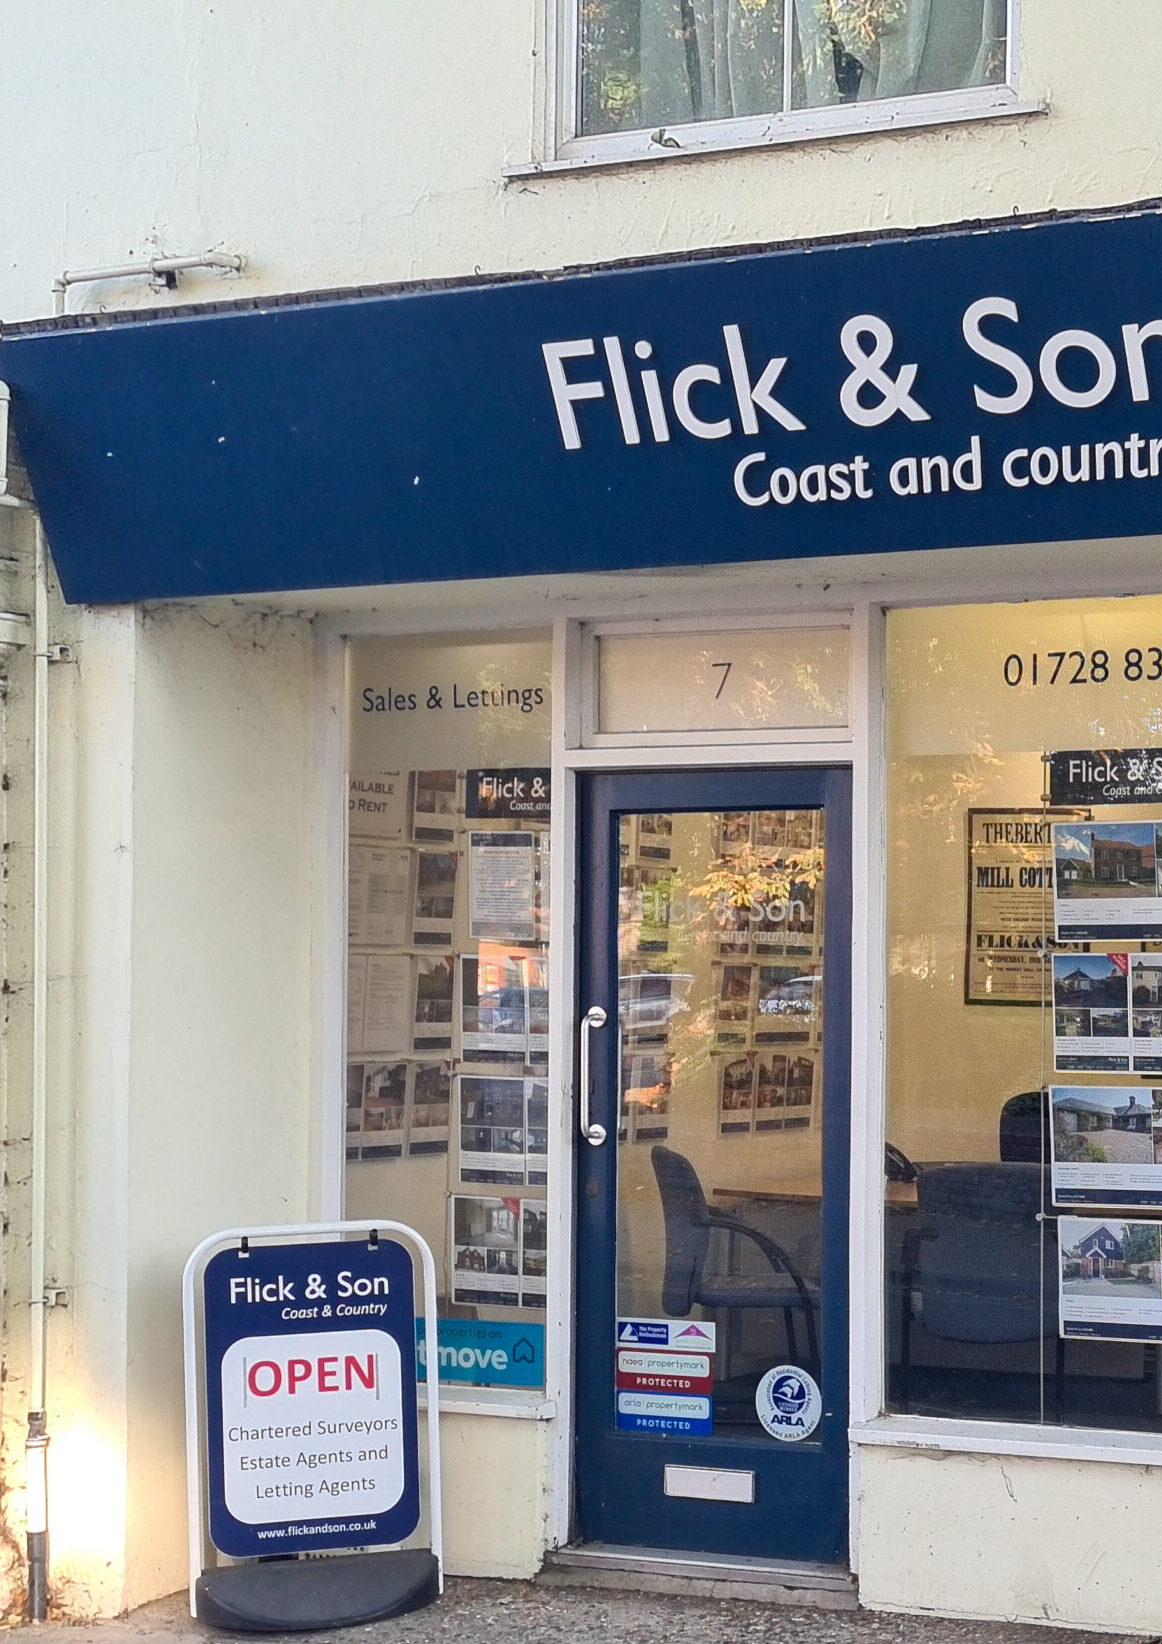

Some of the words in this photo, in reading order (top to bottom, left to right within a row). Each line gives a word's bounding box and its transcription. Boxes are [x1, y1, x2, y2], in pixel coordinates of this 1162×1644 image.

[541, 323, 806, 450] Flick
[839, 314, 931, 427] &
[733, 450, 873, 507] Coast
[888, 434, 983, 494] and
[1003, 650, 1109, 687] 01728
[711, 661, 732, 700] 7
[362, 686, 417, 713] Sales
[426, 685, 443, 711] &
[453, 682, 544, 712] Lettings
[1068, 760, 1119, 783] Flick
[1126, 758, 1144, 780] &
[350, 781, 396, 796] AILABLE
[482, 776, 524, 798] Flick
[531, 776, 546, 798] &
[1102, 783, 1131, 797] Coast
[357, 798, 388, 814] RENT
[510, 801, 534, 812] Coast
[976, 866, 1014, 889] MILL
[1019, 866, 1054, 889] COTT
[976, 934, 1030, 949] FLICK
[229, 1275, 296, 1305] Flick
[304, 1273, 328, 1299] &
[337, 1271, 389, 1298] Son
[281, 1305, 318, 1320] Coast
[321, 1304, 333, 1317] &
[335, 1302, 388, 1318] Country
[248, 1353, 376, 1398] OPEN
[622, 1358, 644, 1367] naea
[647, 1359, 705, 1371] propertymark
[636, 1377, 691, 1389] PROTECTED
[623, 1398, 642, 1408] arla
[646, 1401, 704, 1412] propertymark
[228, 1420, 313, 1443] Chartered
[317, 1416, 398, 1438] Surveyors
[636, 1418, 692, 1431] PROTECTED
[771, 1414, 806, 1428] ARLA
[240, 1452, 291, 1471] Estate
[296, 1448, 354, 1471] Agents
[357, 1445, 389, 1463] and
[255, 1480, 314, 1501] Letting
[318, 1476, 376, 1498] Agents
[257, 1520, 377, 1540] www.flickandson.co.uk
